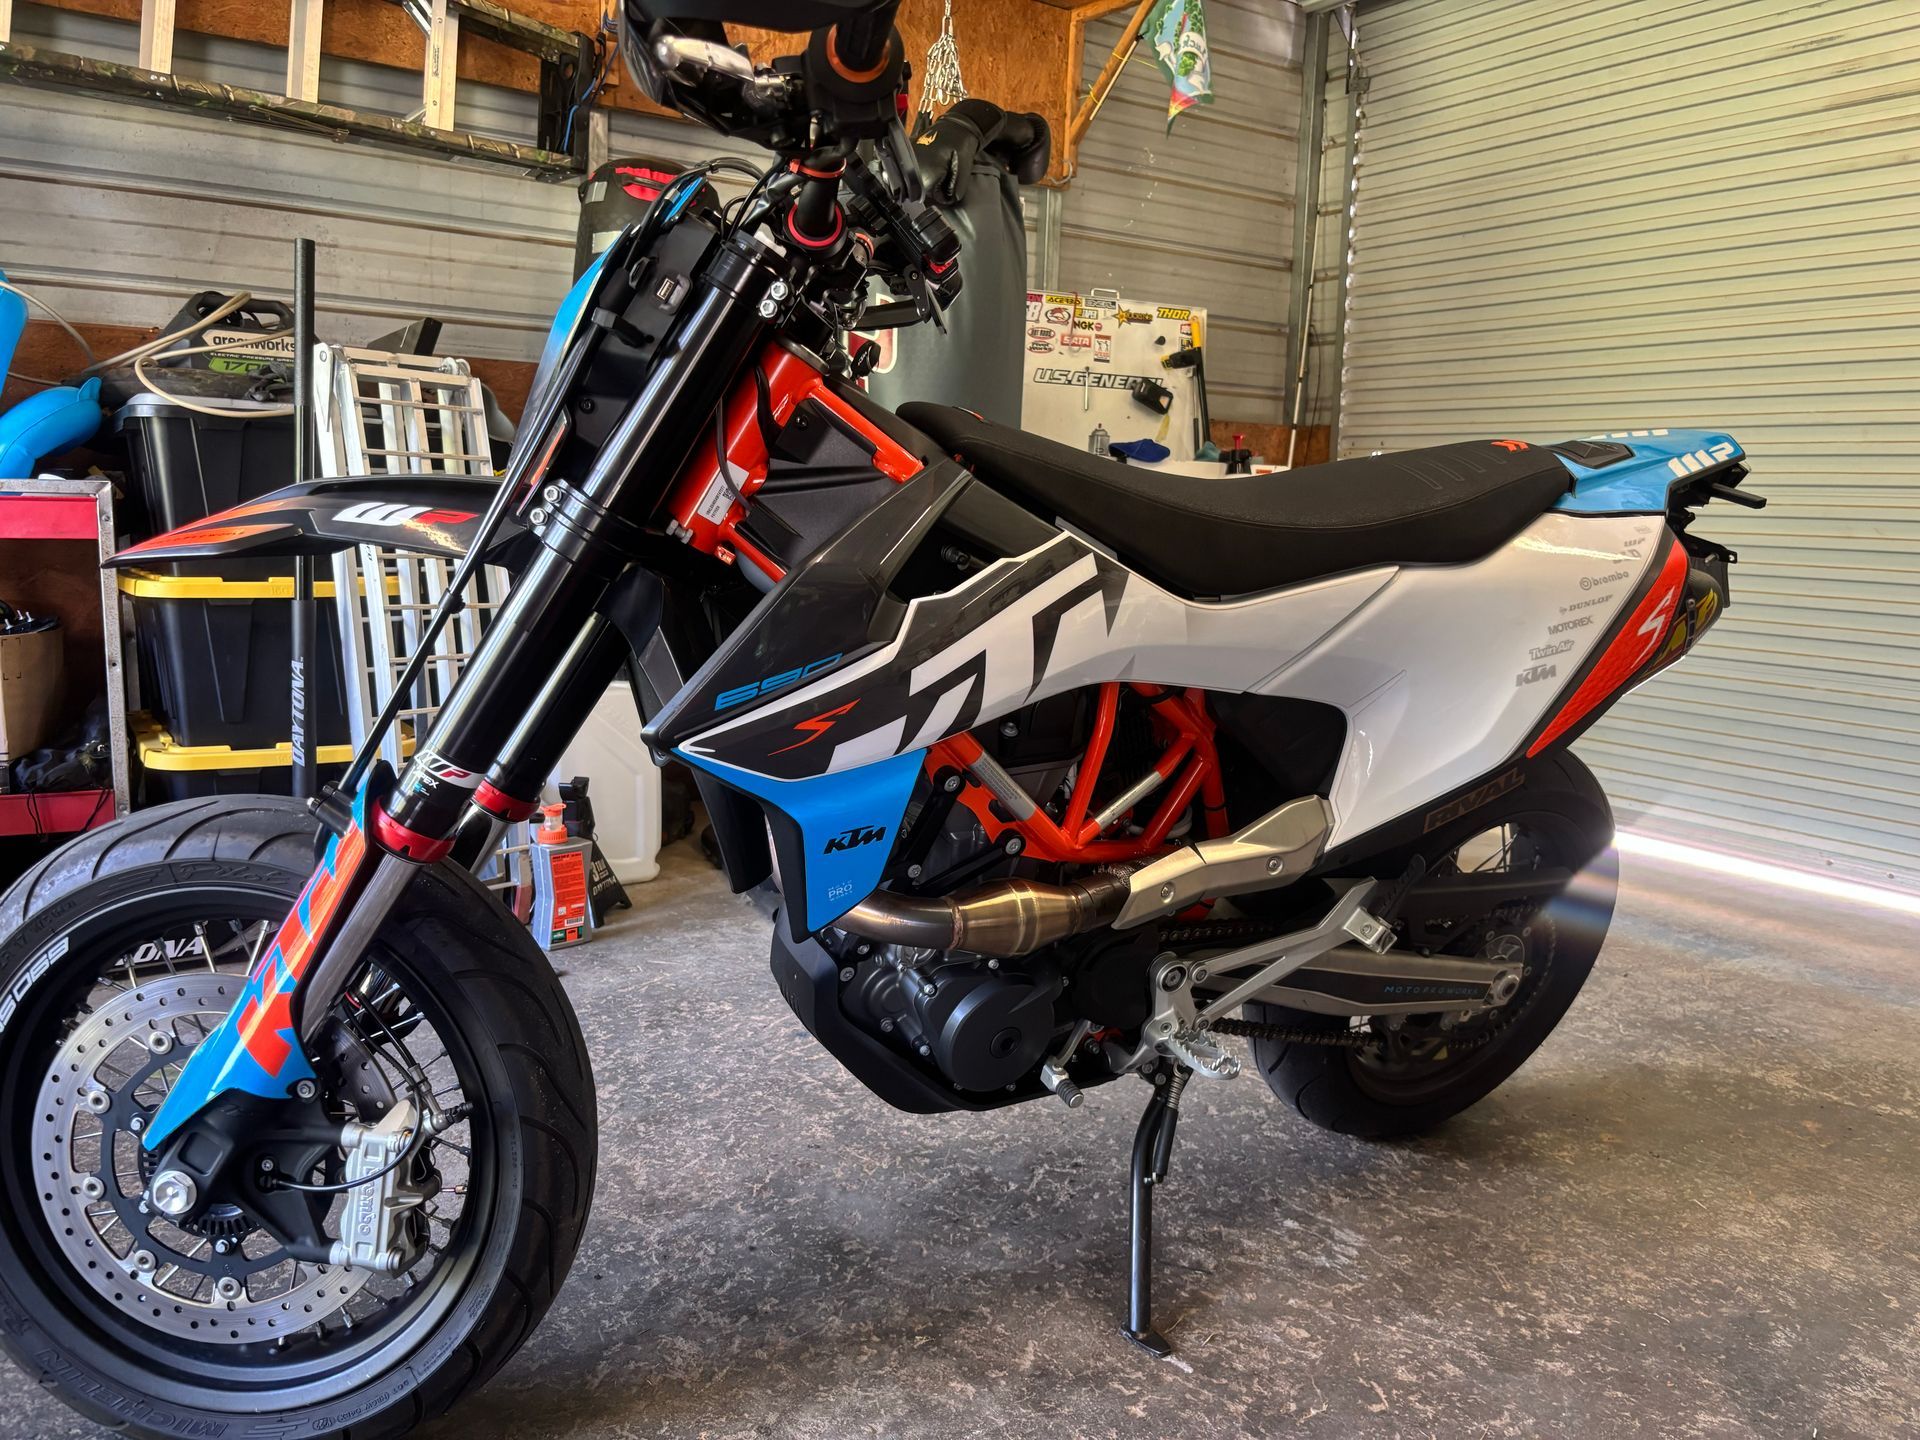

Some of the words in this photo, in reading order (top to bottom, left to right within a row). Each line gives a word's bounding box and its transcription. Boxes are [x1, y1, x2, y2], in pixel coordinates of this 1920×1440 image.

[1157, 307, 1190, 320] THOR
[1073, 320, 1094, 330] NGK
[1062, 335, 1091, 347] SATA
[332, 502, 479, 527] WP
[1592, 571, 1629, 587] brembo
[1568, 594, 1614, 613] DUNLOP
[1547, 615, 1594, 635] MOTOREX
[1529, 643, 1559, 661] Twin
[1557, 639, 1575, 653] Air
[714, 653, 843, 711] 690
[1515, 664, 1557, 687] KTM
[291, 659, 306, 767] DAYTONA
[823, 825, 887, 855] KTM
[828, 883, 853, 899] PRO
